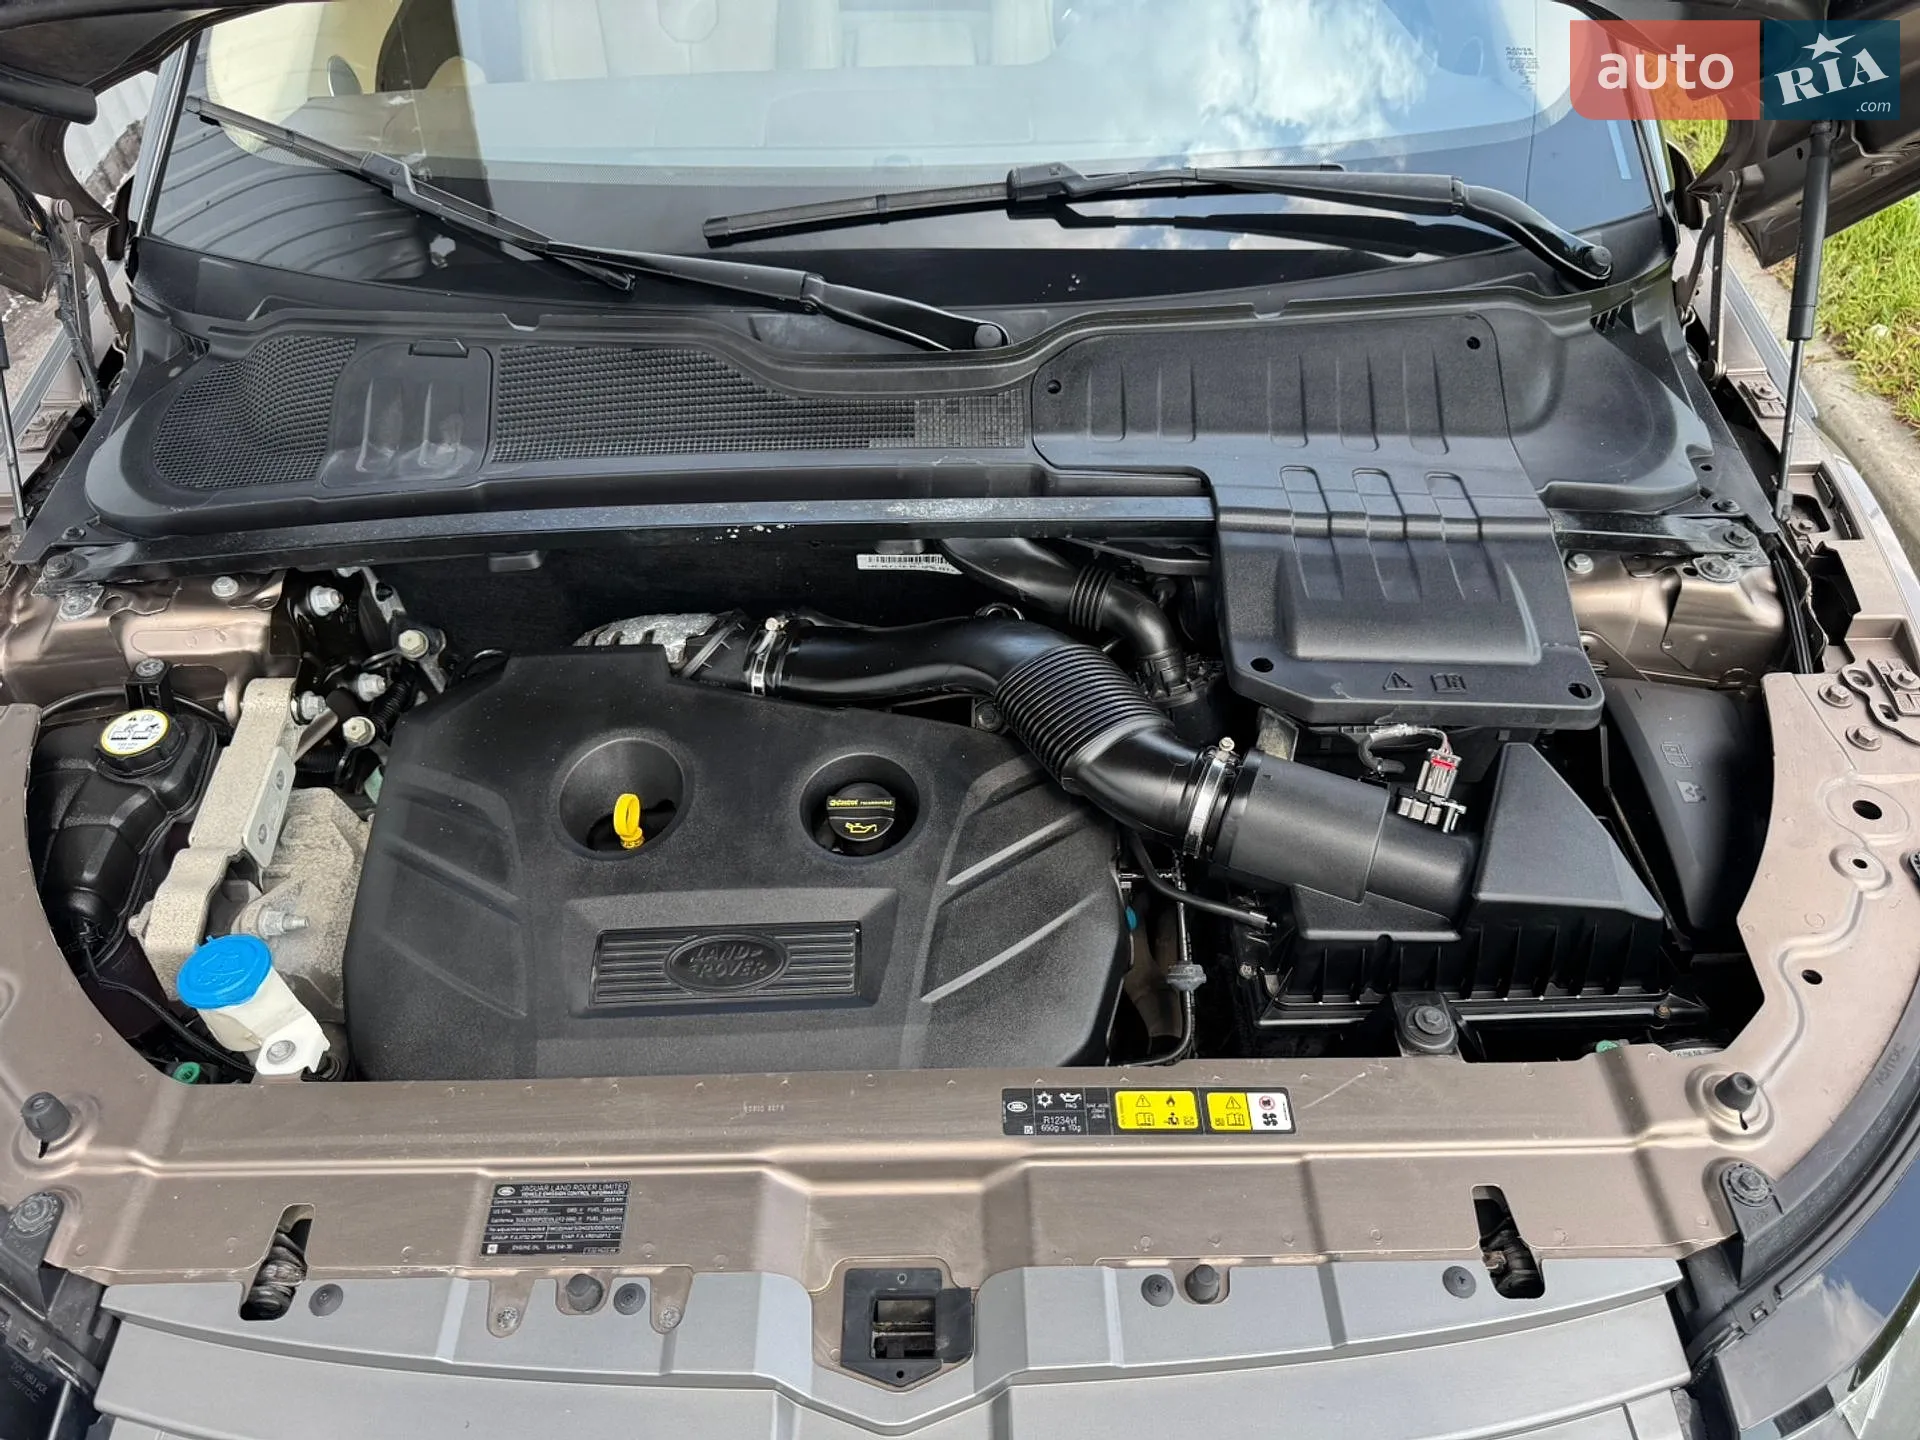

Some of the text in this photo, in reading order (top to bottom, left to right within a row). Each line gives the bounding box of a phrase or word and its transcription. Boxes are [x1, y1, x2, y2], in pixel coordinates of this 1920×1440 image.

[1043, 1116, 1078, 1125] R1234yf
[520, 1184, 550, 1192] JAGUAR
[550, 1184, 572, 1192] LAND
[573, 1183, 598, 1191] ROVER
[599, 1182, 628, 1191] LIMITED
